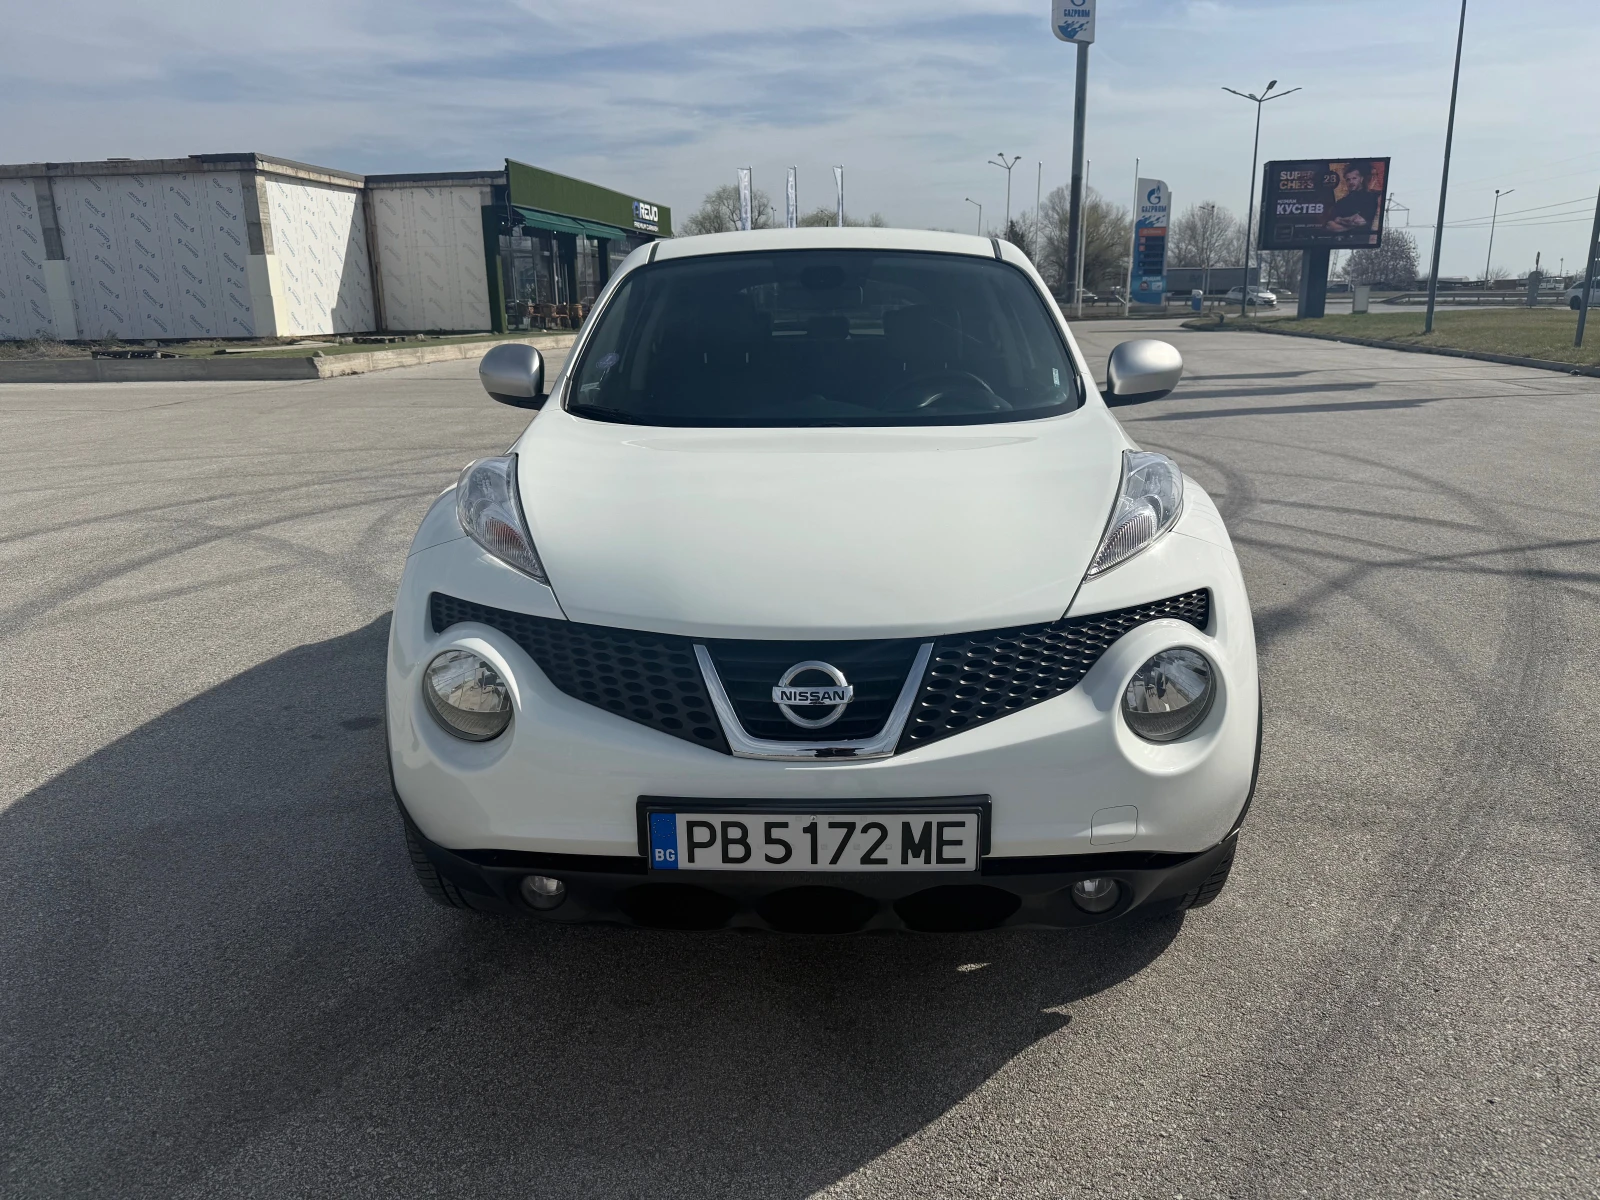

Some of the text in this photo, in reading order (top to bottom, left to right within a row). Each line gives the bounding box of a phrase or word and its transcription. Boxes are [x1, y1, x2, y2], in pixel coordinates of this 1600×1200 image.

[1064, 9, 1090, 17] GAZPROM
[1279, 181, 1314, 189] CHEFS
[1141, 205, 1167, 213] GAZPROM
[1276, 204, 1324, 215] КУСТЕВ
[781, 691, 845, 702] NISSAN
[686, 821, 966, 865] PB 5172 ME
[655, 848, 676, 862] BG
